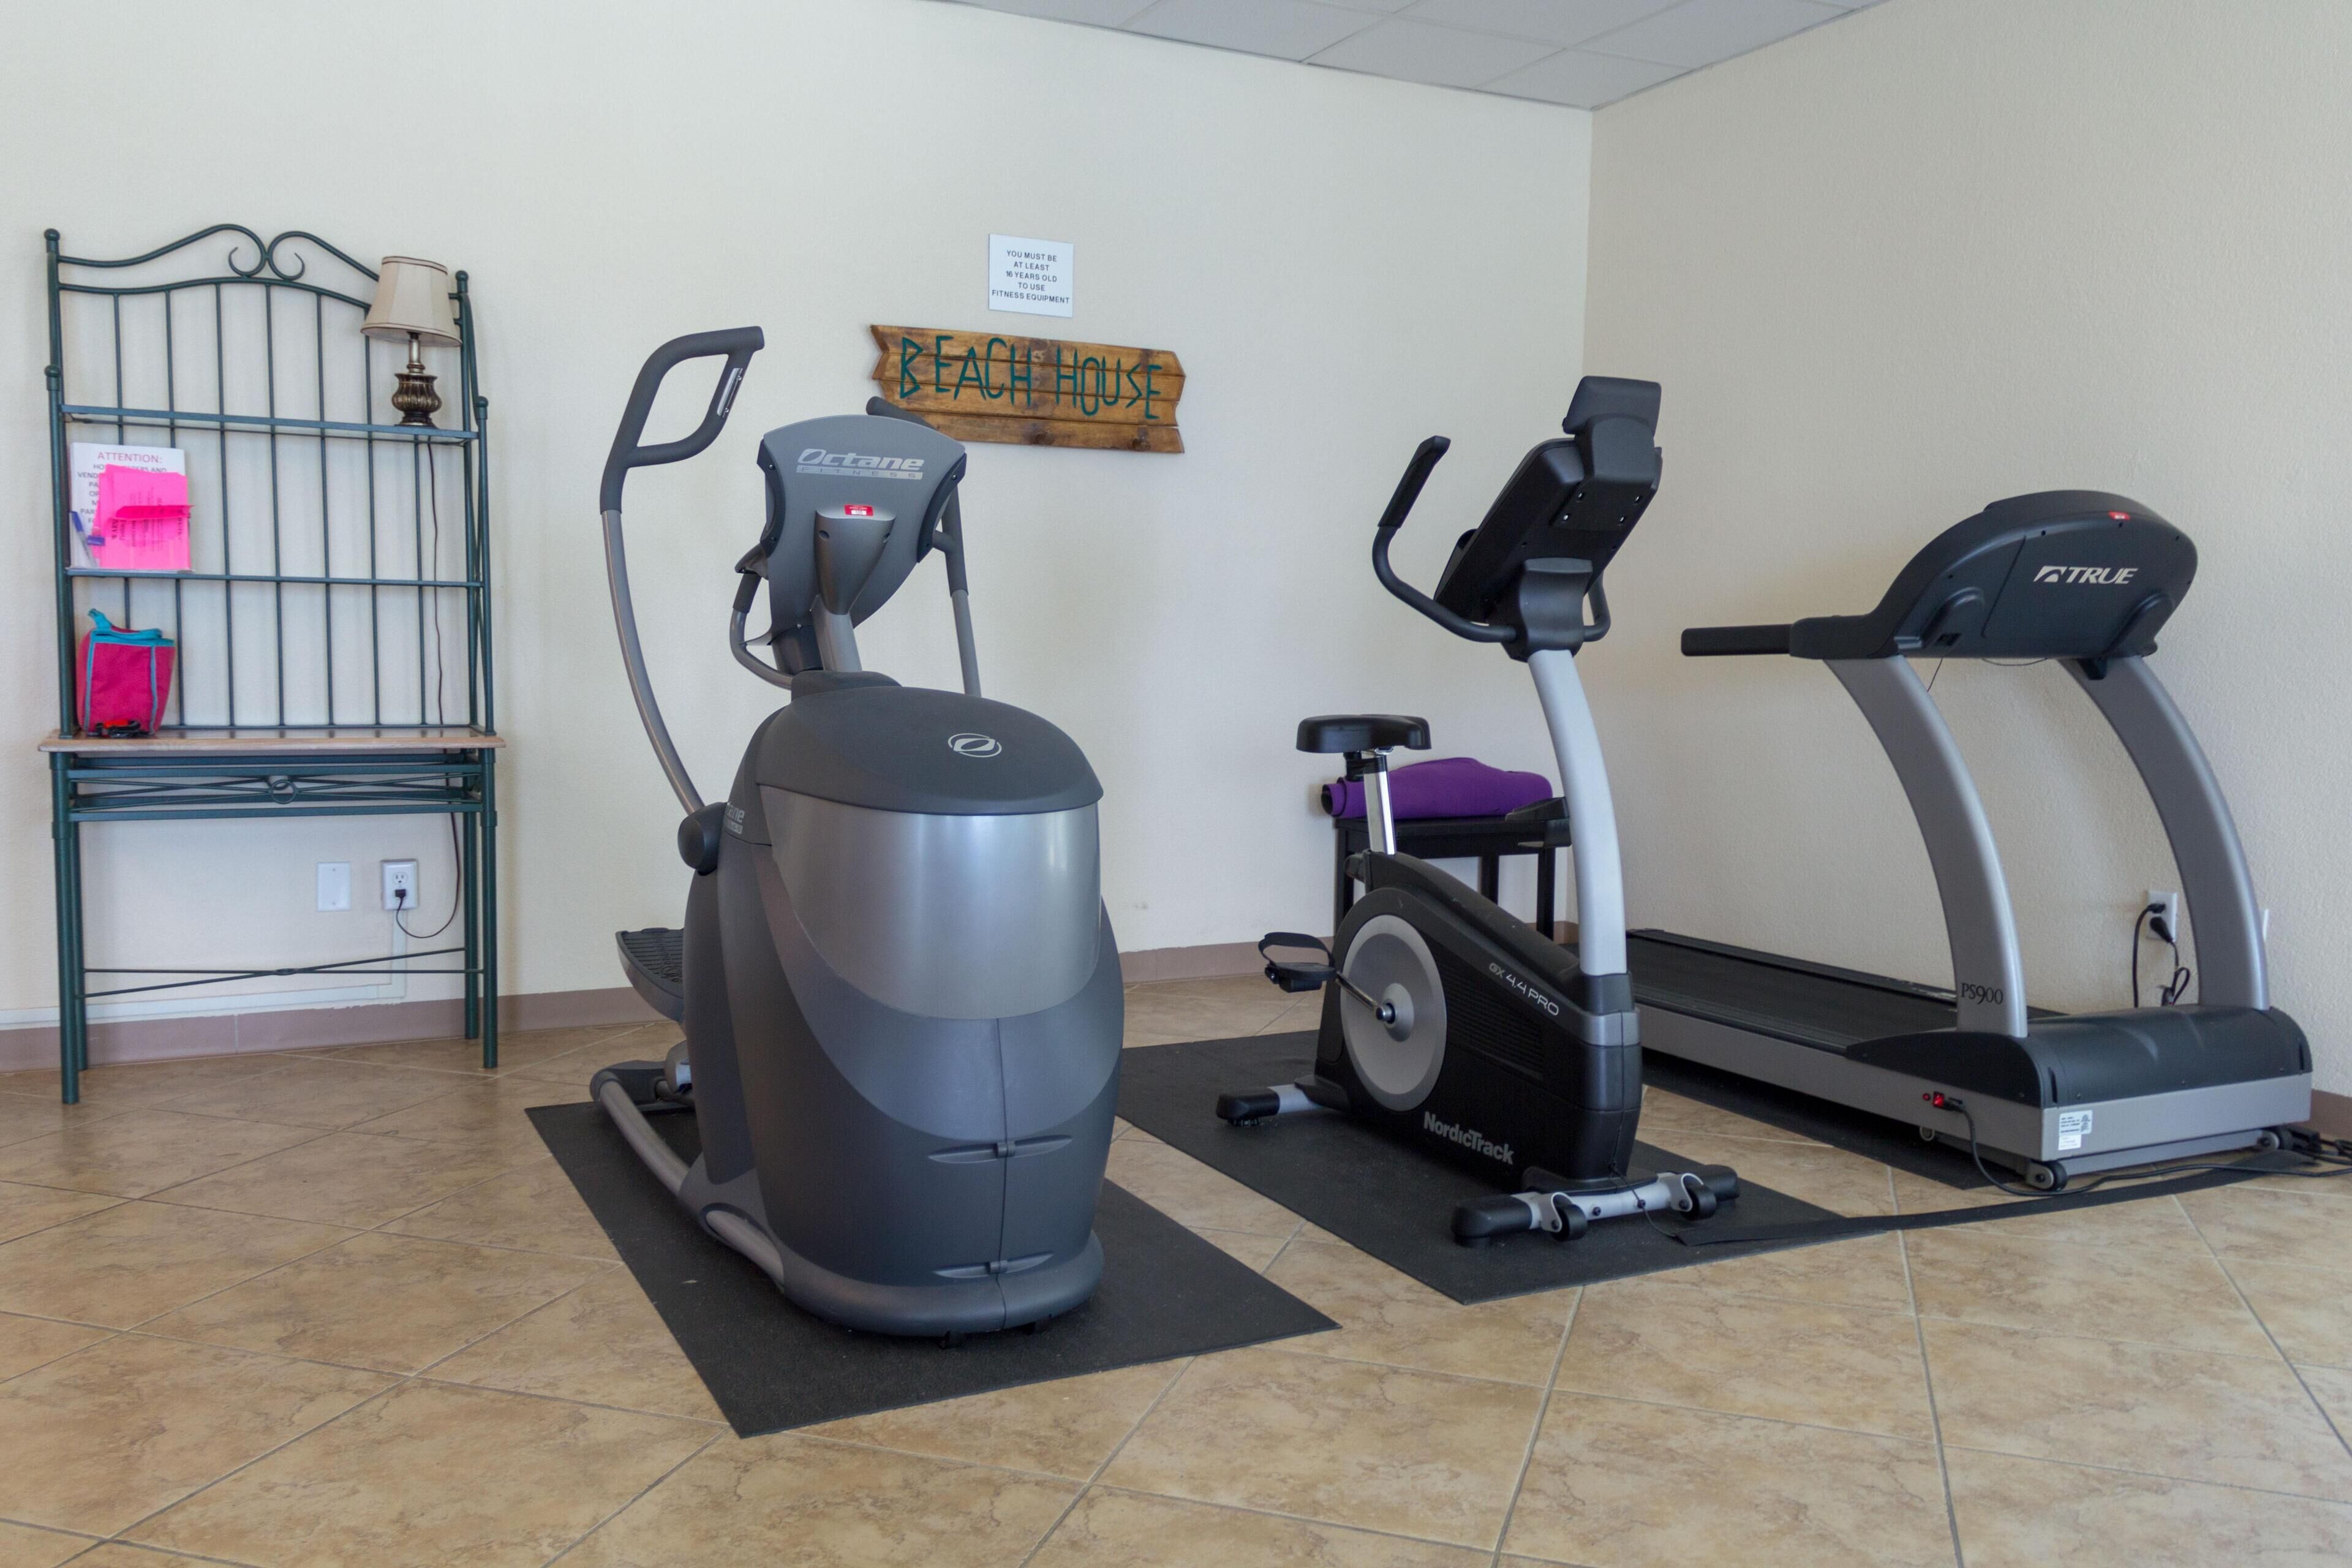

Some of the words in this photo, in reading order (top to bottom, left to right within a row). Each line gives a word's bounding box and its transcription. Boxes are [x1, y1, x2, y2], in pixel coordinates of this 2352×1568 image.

[1024, 252, 1046, 260] MUST
[992, 290, 1024, 299] FITNESS
[1026, 293, 1069, 304] EQUIPMENT
[900, 336, 1031, 407] BEACH
[1055, 344, 1163, 419] HOUSE
[97, 451, 162, 463] ATTENTION:
[797, 448, 924, 471] Octane
[801, 468, 917, 478] FITNESS
[2065, 567, 2139, 584] TRUE
[1489, 962, 1506, 978] GX
[1506, 974, 1527, 995] 4.4
[1528, 988, 1559, 1016] PRO
[1961, 982, 2003, 1005] PS900
[1423, 1112, 1514, 1164] NordicTrack
